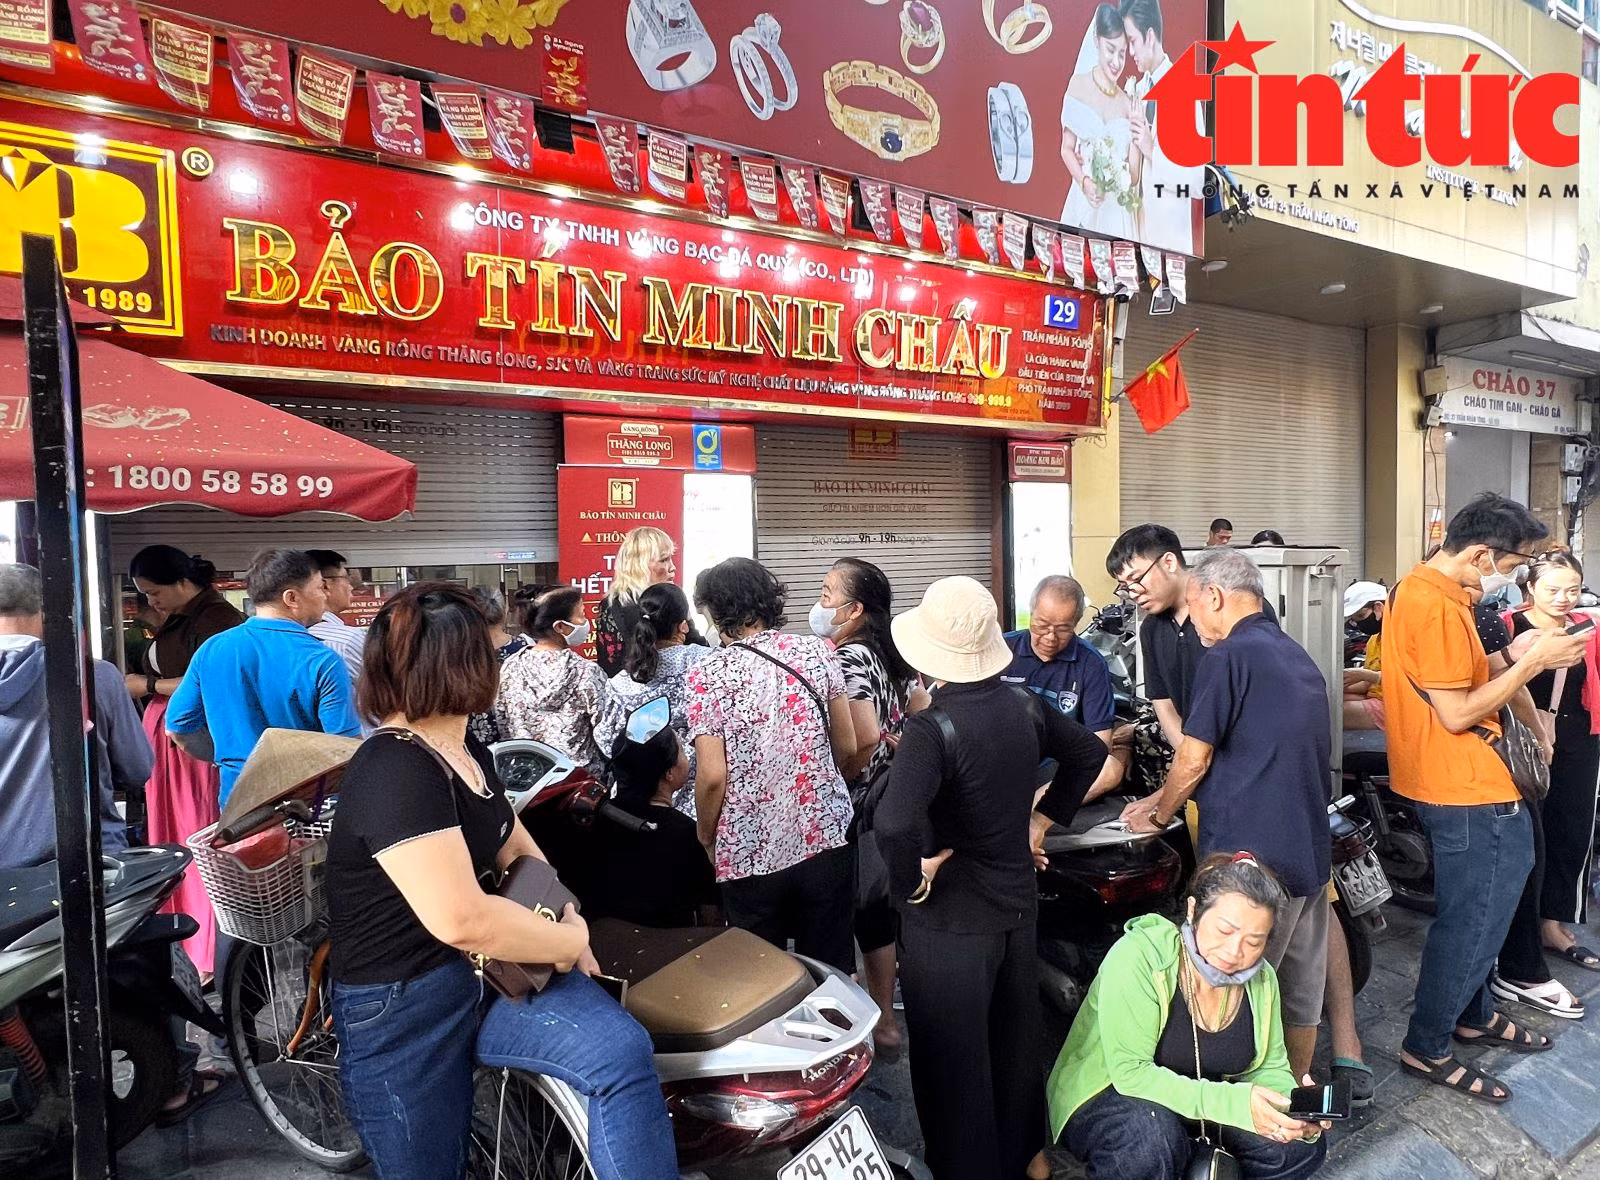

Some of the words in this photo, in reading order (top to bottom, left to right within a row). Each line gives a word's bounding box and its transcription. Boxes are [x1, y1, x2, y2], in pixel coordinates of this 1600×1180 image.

[457, 201, 524, 231] CÔNG
[564, 220, 620, 247] TNHH
[626, 228, 680, 255] VÀNG
[685, 240, 722, 265] BẠC
[83, 286, 152, 313] 1989
[223, 200, 445, 322] BẢO
[466, 222, 627, 342] TÍN
[643, 275, 845, 364] MINH
[855, 297, 1013, 381] CHÂU
[1052, 299, 1076, 323] 29
[1022, 328, 1045, 344] TRẦN
[211, 323, 256, 345] KINH
[332, 334, 381, 355] VÀNG
[386, 338, 433, 360] RỒNG
[437, 345, 492, 365] THĂNG
[496, 351, 543, 372] LONG,
[545, 357, 571, 372] SJC
[575, 356, 593, 374] VÀ
[597, 358, 634, 377] VÀNG
[637, 365, 680, 381] TRANG
[681, 366, 707, 383] SỨC
[729, 372, 761, 391] NGHỆ
[763, 373, 793, 390] CHẤT
[1535, 379, 1556, 400] 37
[1488, 398, 1504, 411] TIM
[1505, 400, 1523, 413] GAN
[609, 438, 644, 450] THĂNG
[645, 440, 671, 451] LONG
[107, 464, 192, 491] 1800
[201, 469, 241, 494] 58
[250, 470, 288, 496] 58
[297, 474, 334, 498] 99
[580, 510, 599, 519] BẢO
[600, 510, 616, 520] TÍN
[618, 511, 641, 520] MINH
[642, 510, 667, 520] CHÂU
[595, 531, 626, 543] THÔN
[858, 532, 871, 544] 9h
[880, 532, 897, 544] 19h
[571, 571, 613, 594] HẾT
[808, 1052, 847, 1082] HONDA
